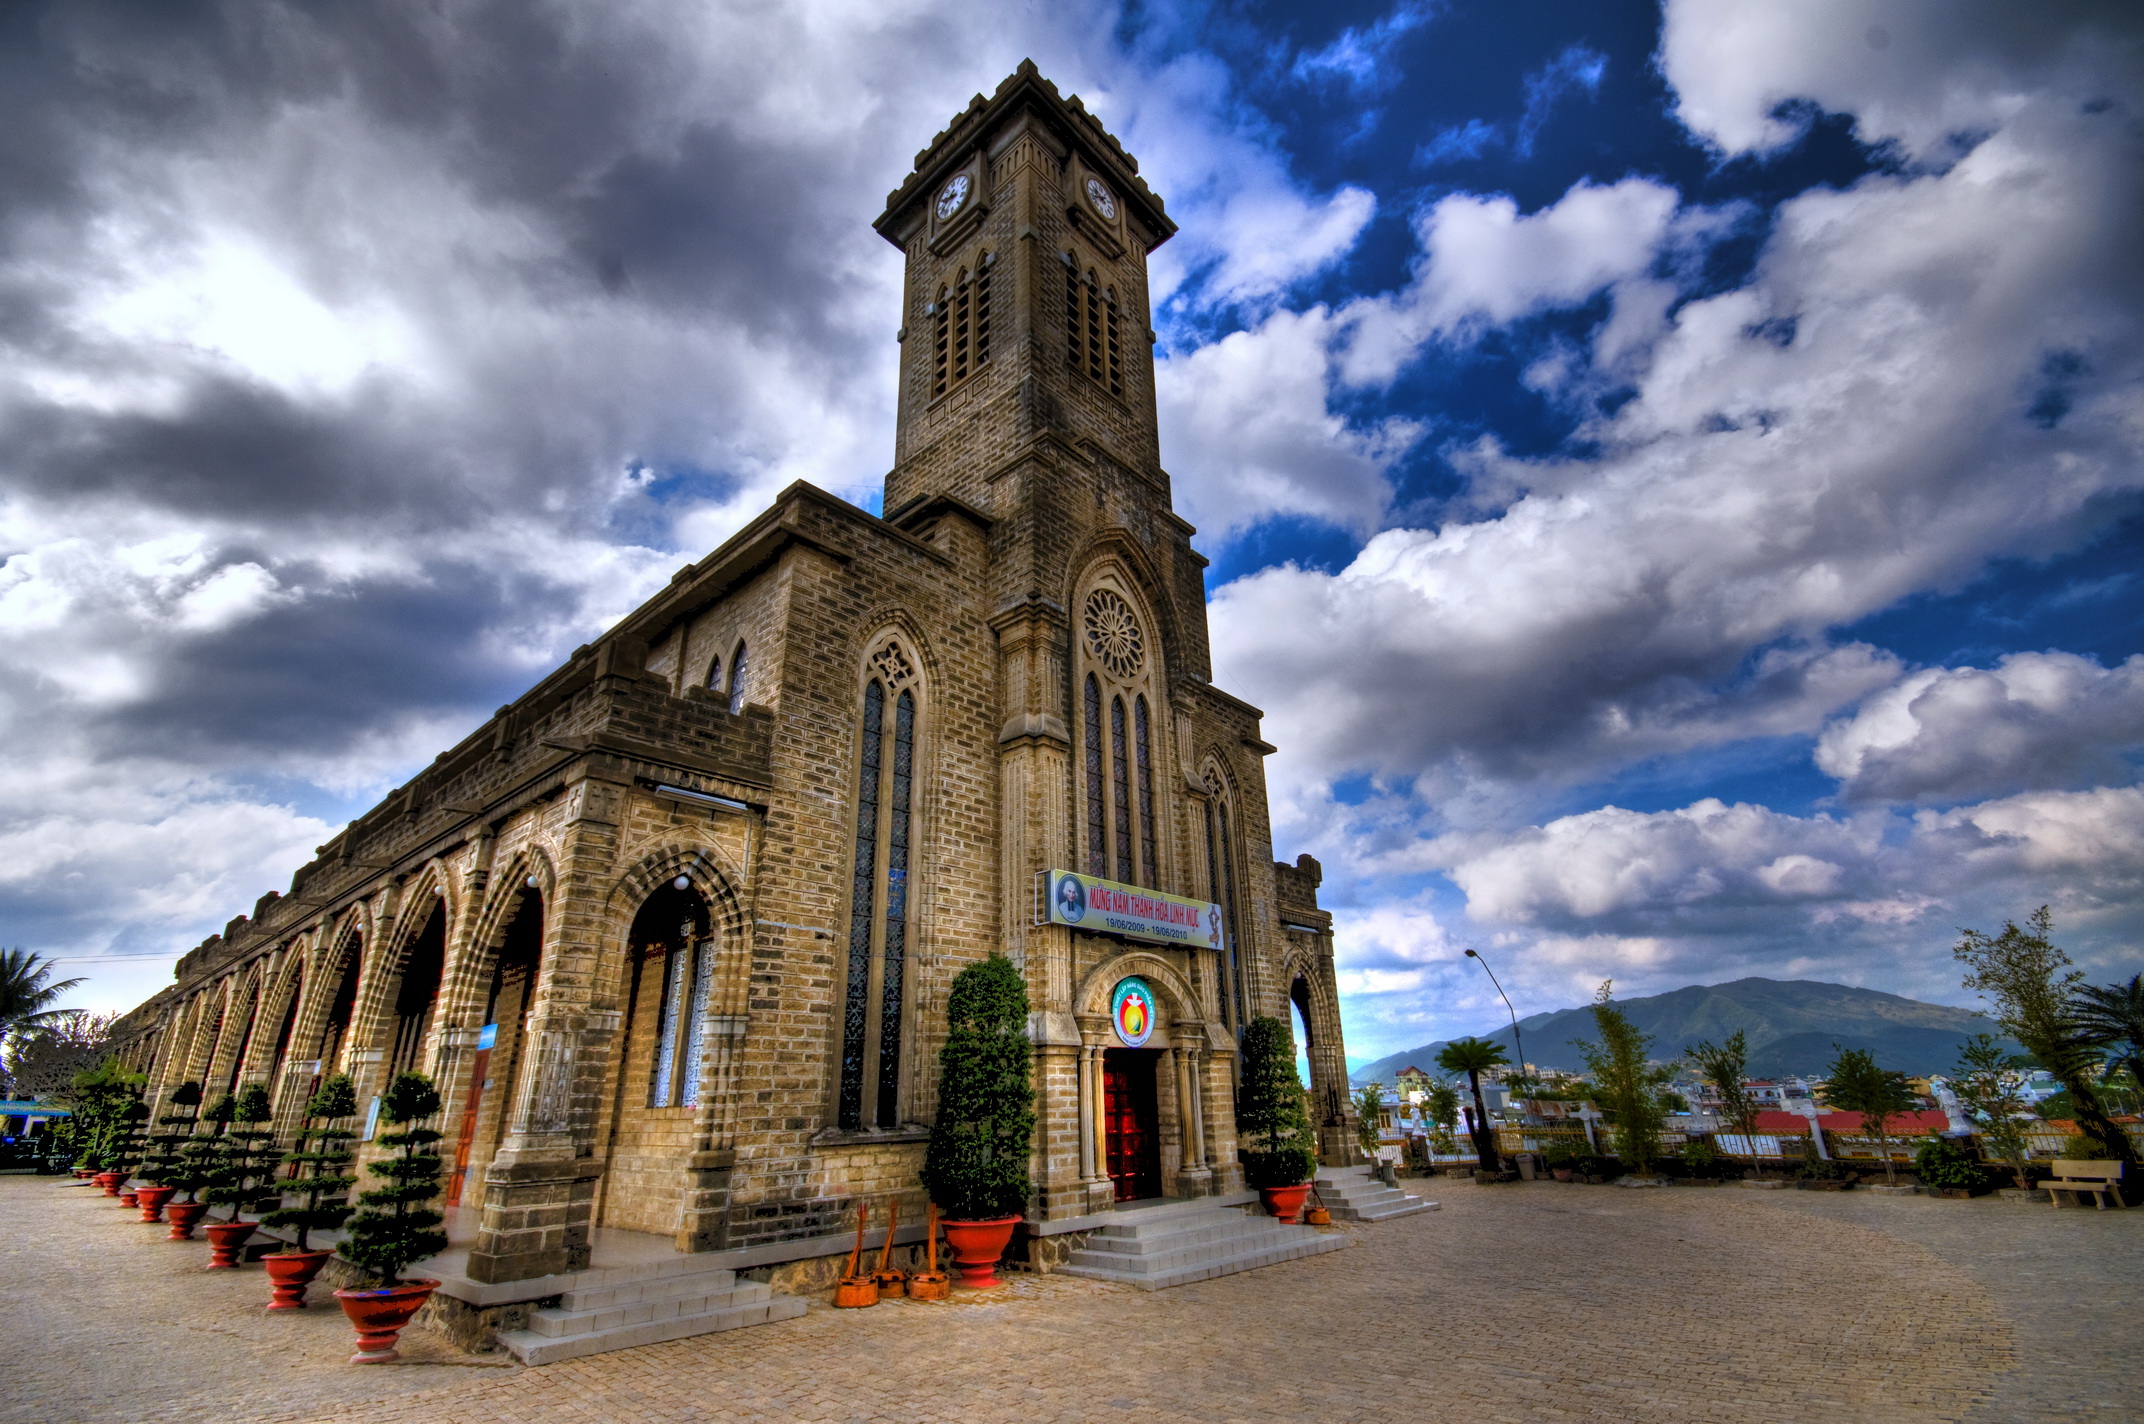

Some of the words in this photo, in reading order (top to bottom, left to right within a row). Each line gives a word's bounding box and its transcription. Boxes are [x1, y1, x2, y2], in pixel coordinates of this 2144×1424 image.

[1089, 882, 1111, 911] MỪNG
[1112, 886, 1129, 915] NĂM
[1130, 891, 1154, 918] THÁNH
[1169, 902, 1184, 925] LINH
[1185, 905, 1199, 932] MỤC
[1106, 917, 1145, 932] 19/06/2009
[1152, 926, 1188, 940] 19/06/2010
